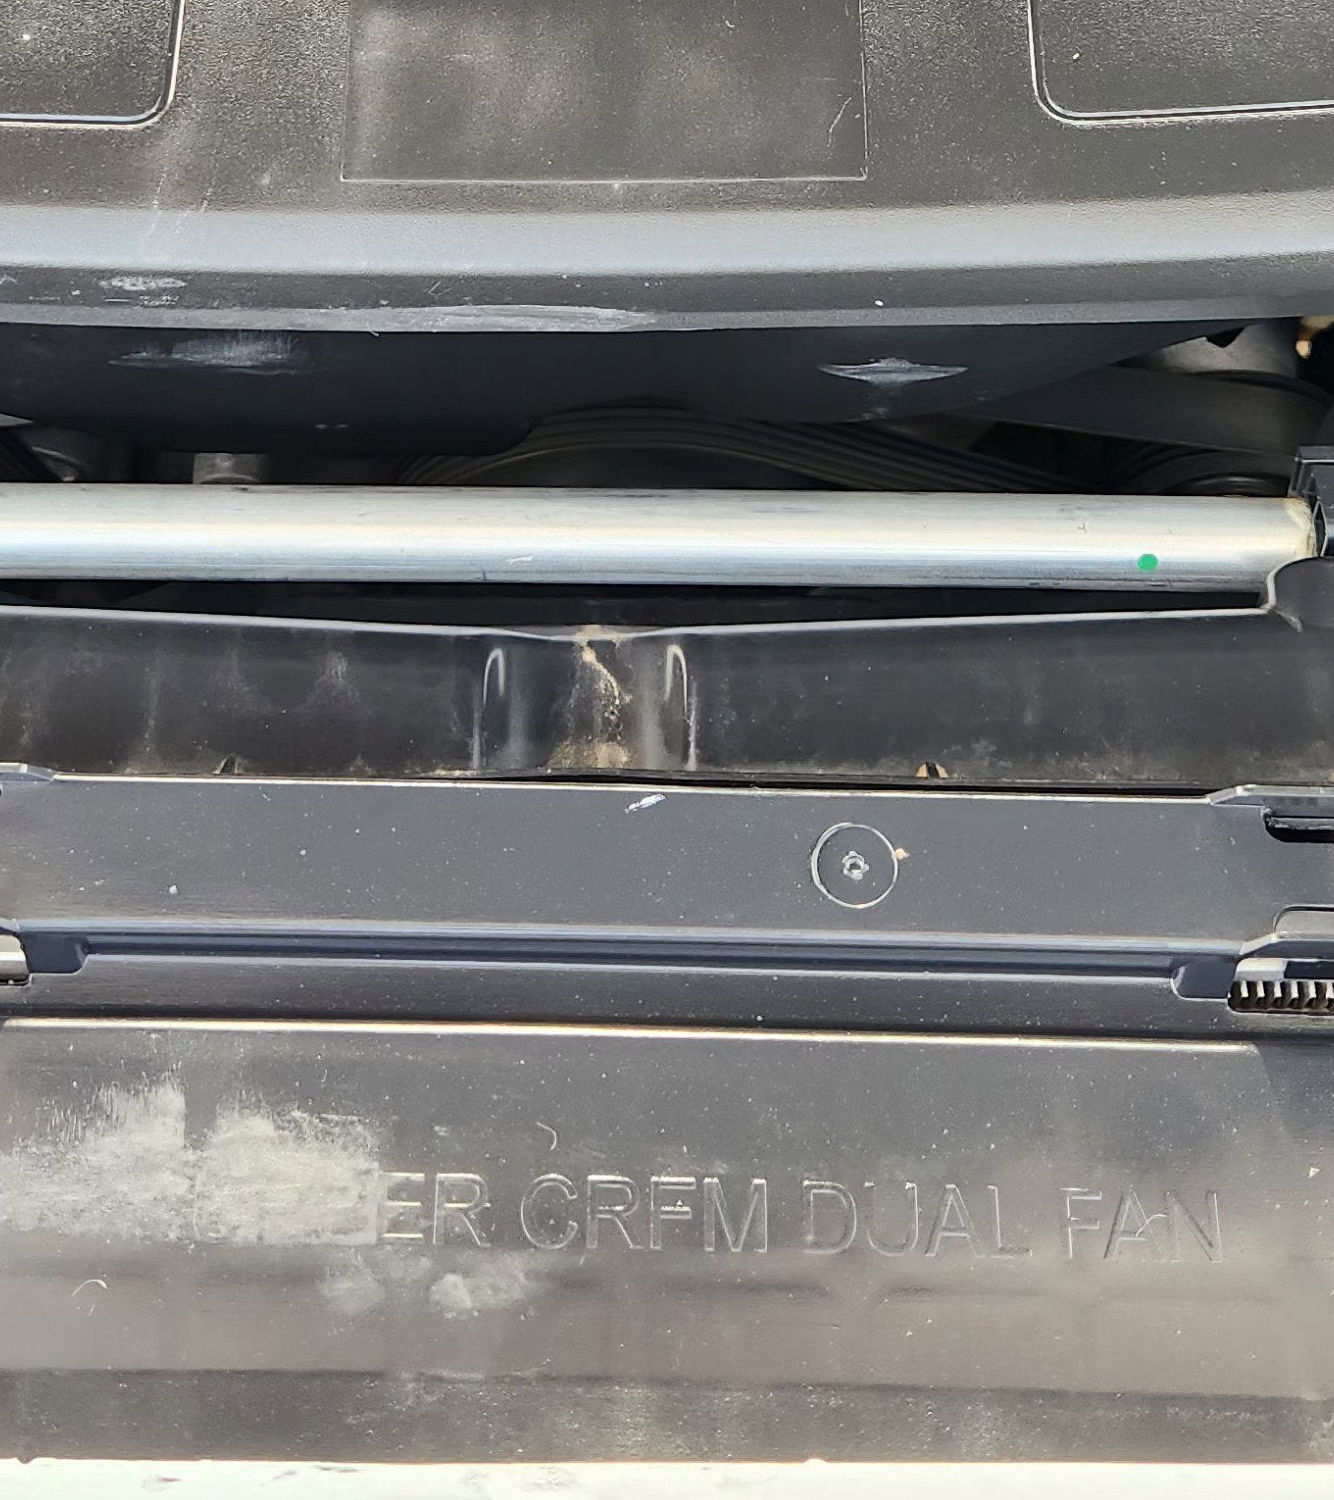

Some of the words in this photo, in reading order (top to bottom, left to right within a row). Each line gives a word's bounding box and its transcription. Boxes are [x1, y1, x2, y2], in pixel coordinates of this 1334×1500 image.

[520, 1173, 768, 1252] CRFM
[802, 1180, 1034, 1258] DUAL
[1059, 1187, 1224, 1264] FAN
